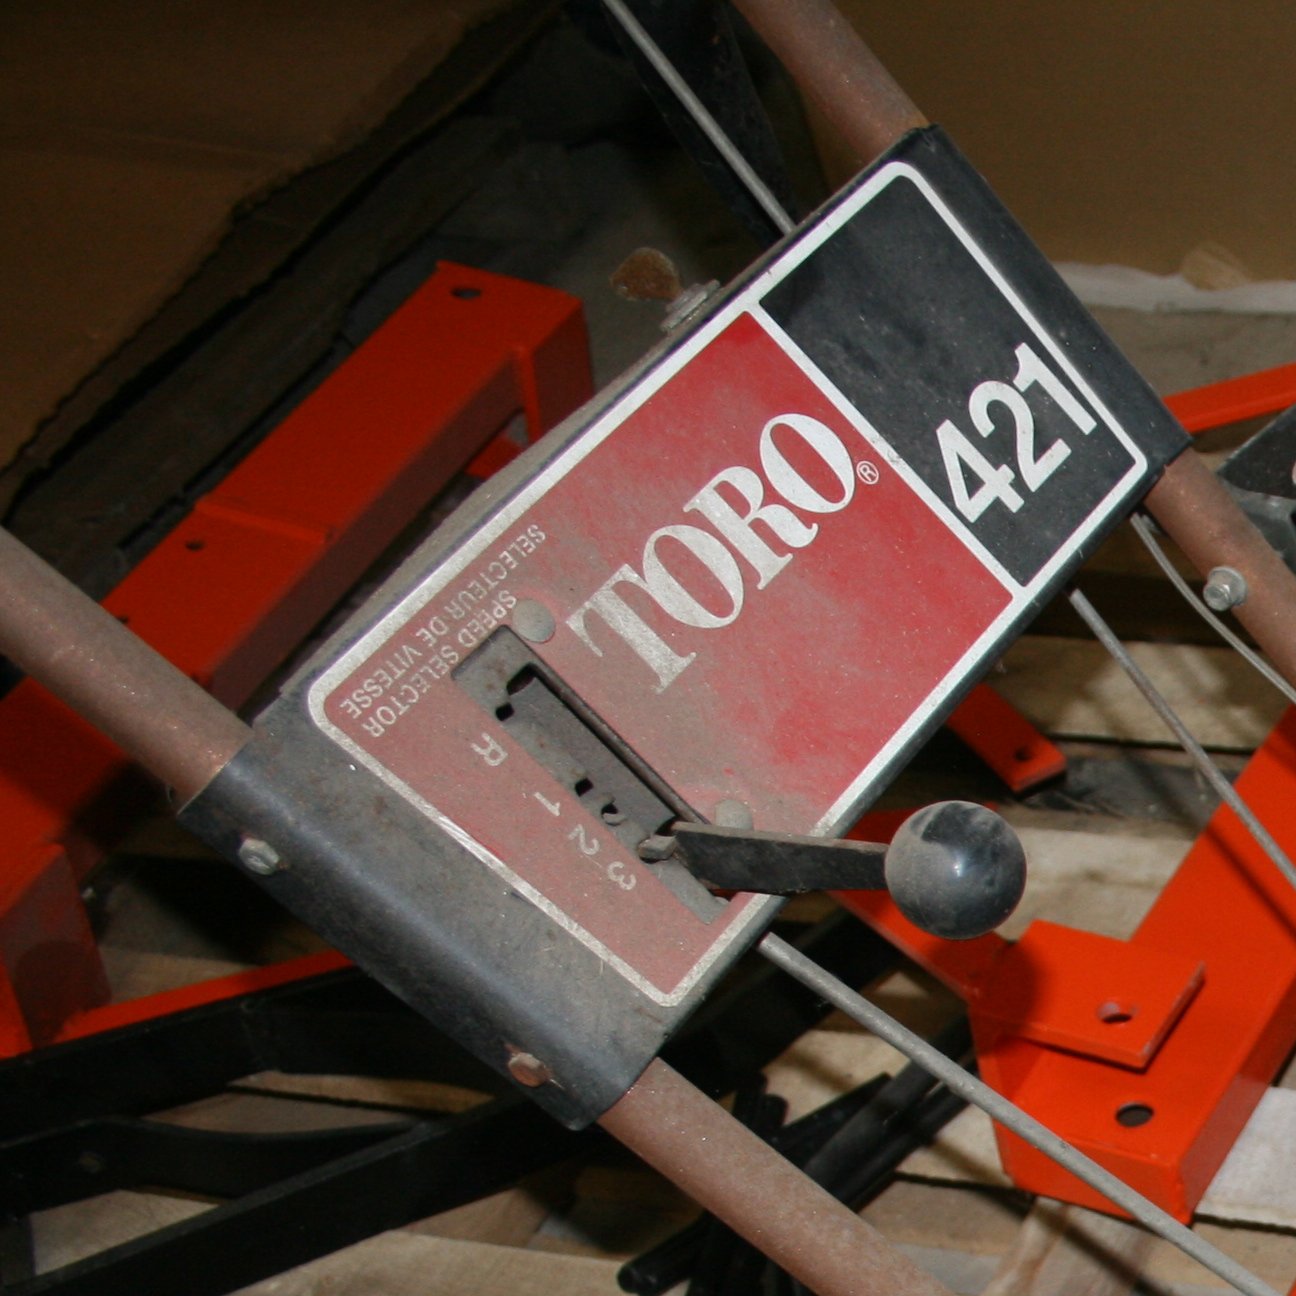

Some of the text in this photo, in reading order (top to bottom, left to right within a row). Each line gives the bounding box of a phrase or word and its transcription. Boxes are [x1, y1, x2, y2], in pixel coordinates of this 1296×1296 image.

[936, 342, 1098, 523] 421
[565, 413, 856, 694] TORO
[339, 524, 546, 719] SELECTEUR DE VITESSE
[362, 590, 517, 738] SPEED SELECTOR
[470, 732, 508, 767] R
[534, 791, 560, 817] 1
[568, 824, 600, 856] 2
[606, 861, 637, 891] 3
